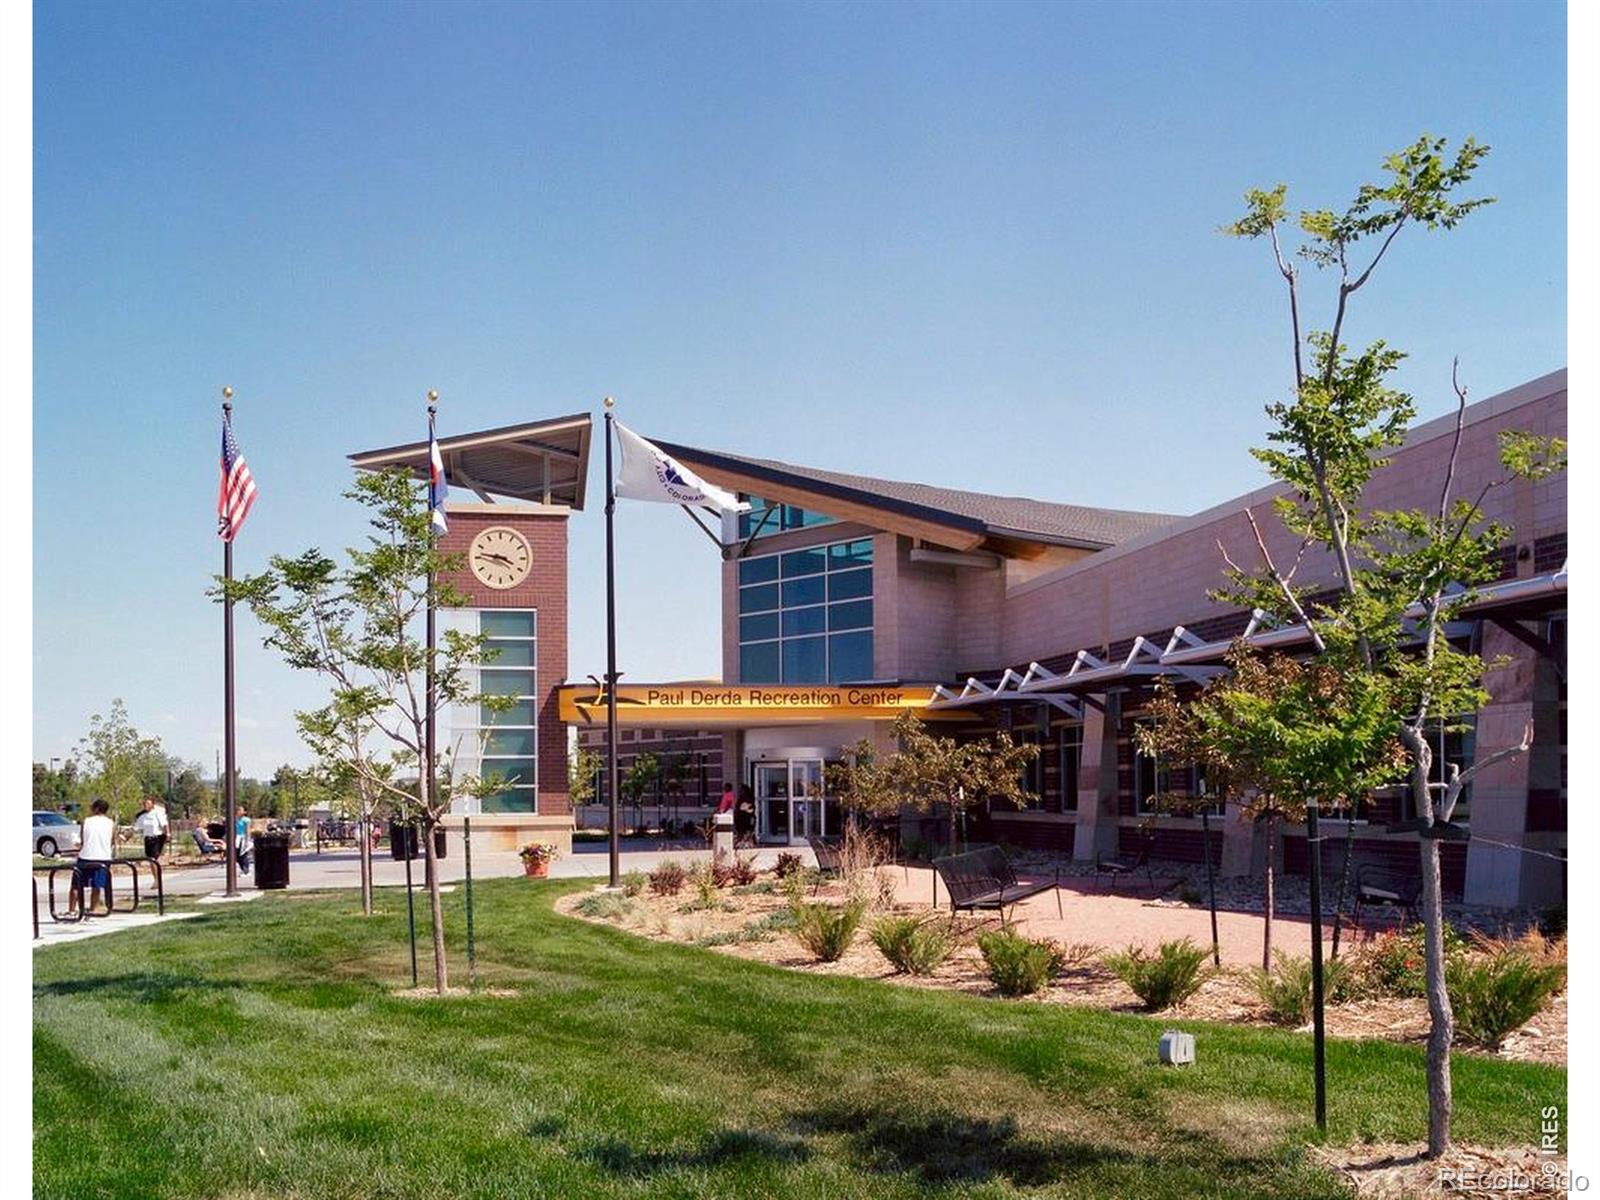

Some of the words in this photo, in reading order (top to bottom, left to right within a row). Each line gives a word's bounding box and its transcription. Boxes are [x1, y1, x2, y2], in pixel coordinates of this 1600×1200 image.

[648, 690, 684, 705] Paul
[691, 690, 742, 705] Derda
[750, 690, 841, 705] Recreation
[848, 690, 903, 705] Center
